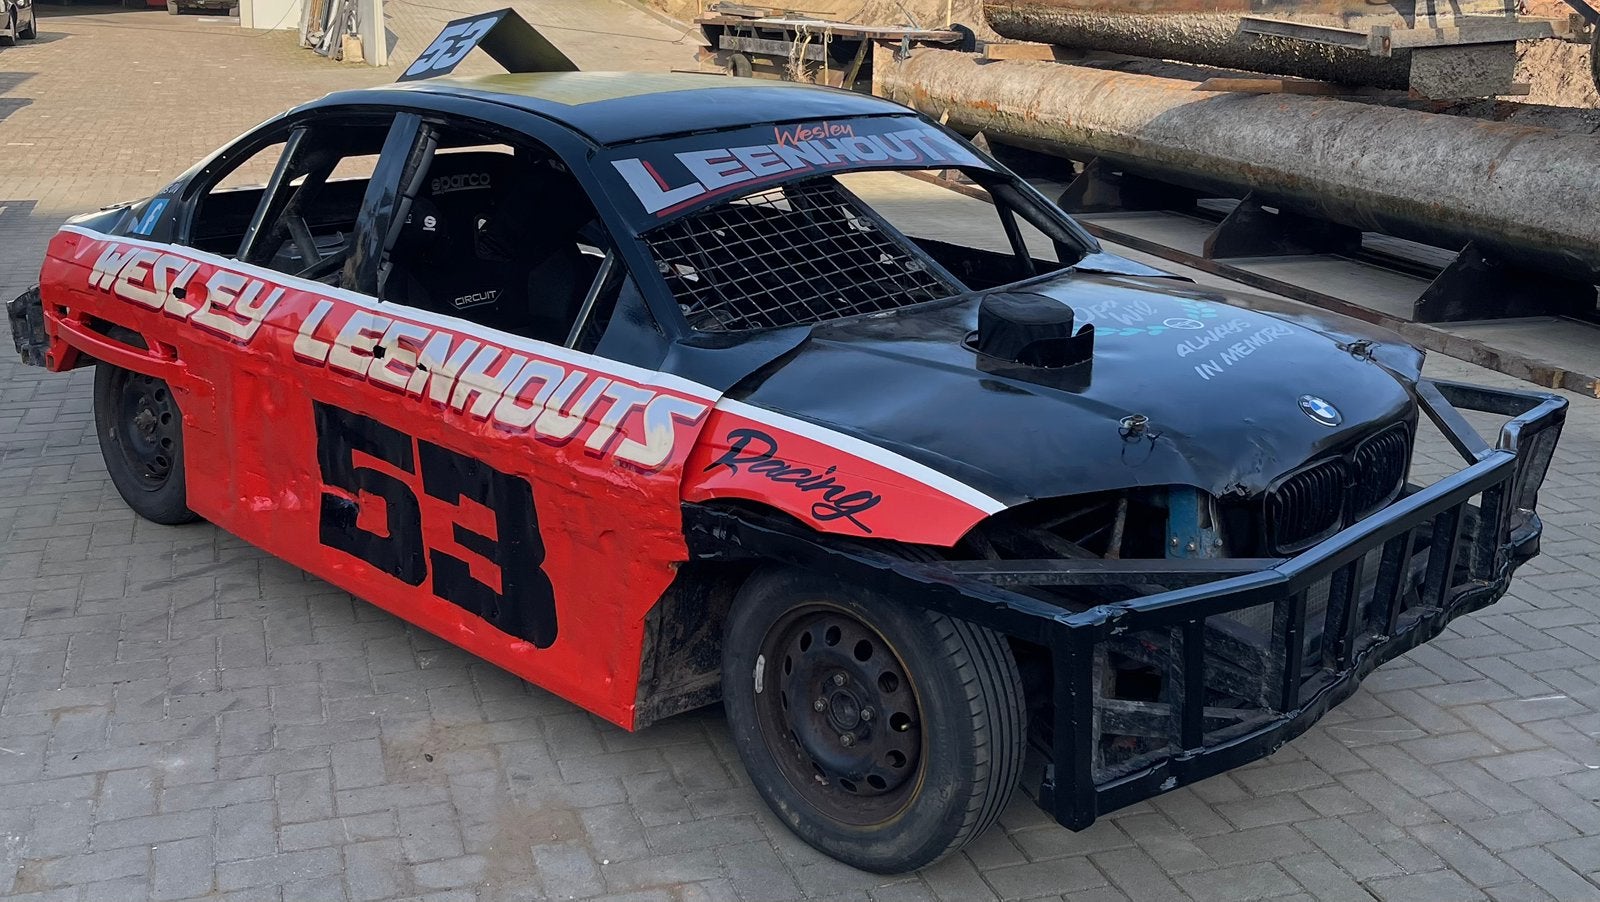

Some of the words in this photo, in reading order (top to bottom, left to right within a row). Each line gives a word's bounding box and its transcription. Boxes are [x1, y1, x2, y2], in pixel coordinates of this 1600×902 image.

[406, 16, 498, 76] 53
[774, 121, 856, 150] Wesley
[431, 172, 491, 195] sparco
[454, 290, 497, 306] CIRCUIT
[87, 243, 286, 342] WESLEY
[292, 298, 708, 470] LEENHOUTS
[1176, 318, 1252, 358] ALWAYS
[1194, 359, 1223, 380] IN
[1219, 323, 1295, 366] MEMORY
[703, 427, 882, 534] Racing
[314, 401, 558, 649] 53
